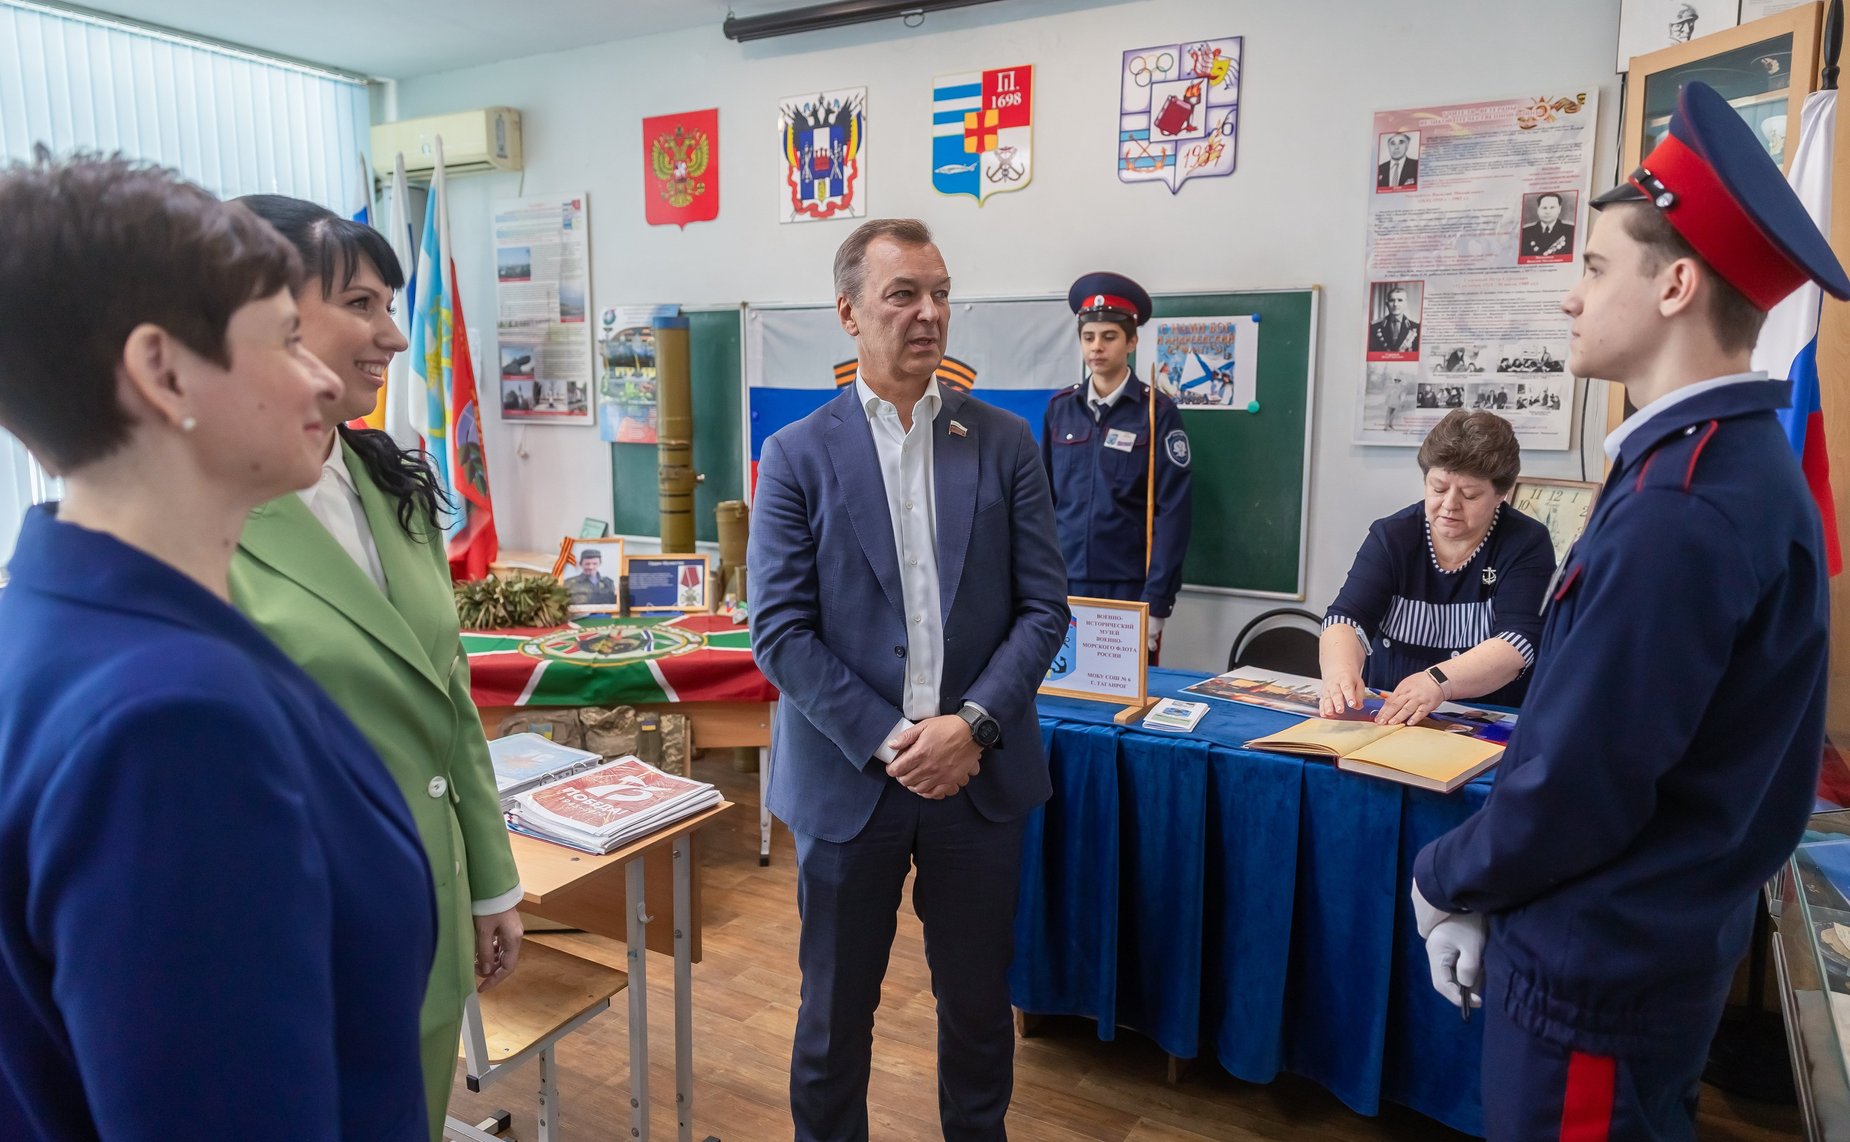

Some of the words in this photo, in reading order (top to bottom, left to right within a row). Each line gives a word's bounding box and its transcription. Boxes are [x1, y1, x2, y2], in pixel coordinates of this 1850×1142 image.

[991, 92, 1022, 109] 1698
[1530, 488, 1543, 500] 11
[1549, 490, 1563, 502] 12
[1571, 492, 1579, 503] 1
[1517, 500, 1531, 511] 10
[1579, 506, 1588, 517] 2
[1086, 621, 1134, 629] ИСТОРИЧЕСКИЙ
[1082, 642, 1115, 651] МОРСКОГО
[1097, 681, 1127, 689] ТАГАНРОГ
[562, 787, 628, 814] ПОБЕДА!
